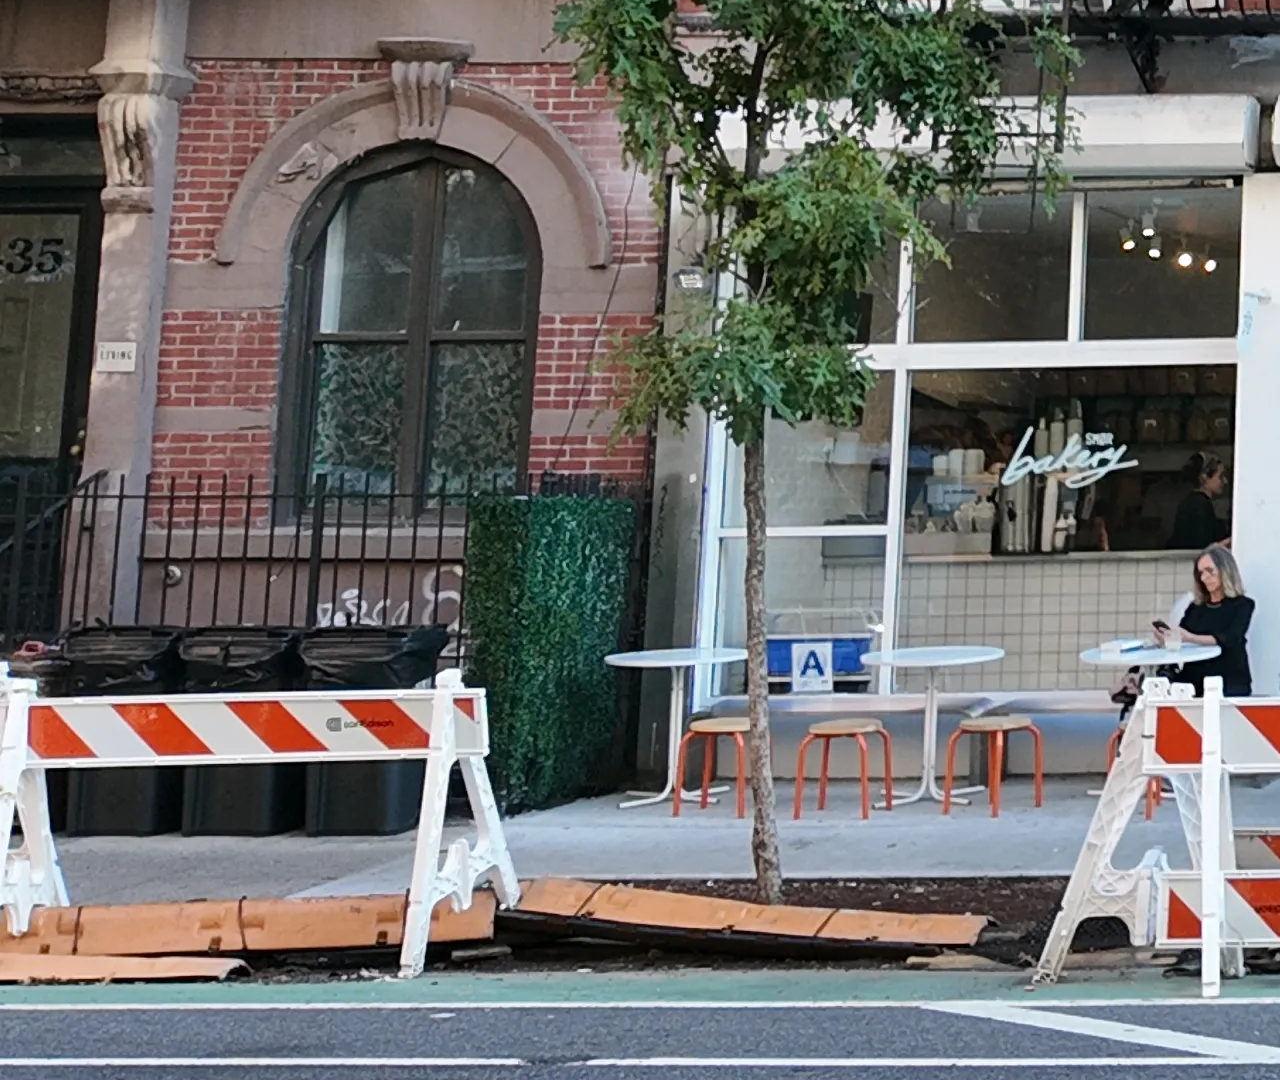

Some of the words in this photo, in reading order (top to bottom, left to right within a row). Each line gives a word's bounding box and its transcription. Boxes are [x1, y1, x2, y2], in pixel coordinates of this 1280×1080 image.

[0, 237, 64, 274] 35
[1001, 425, 1139, 488] bakery
[800, 650, 825, 676] A
